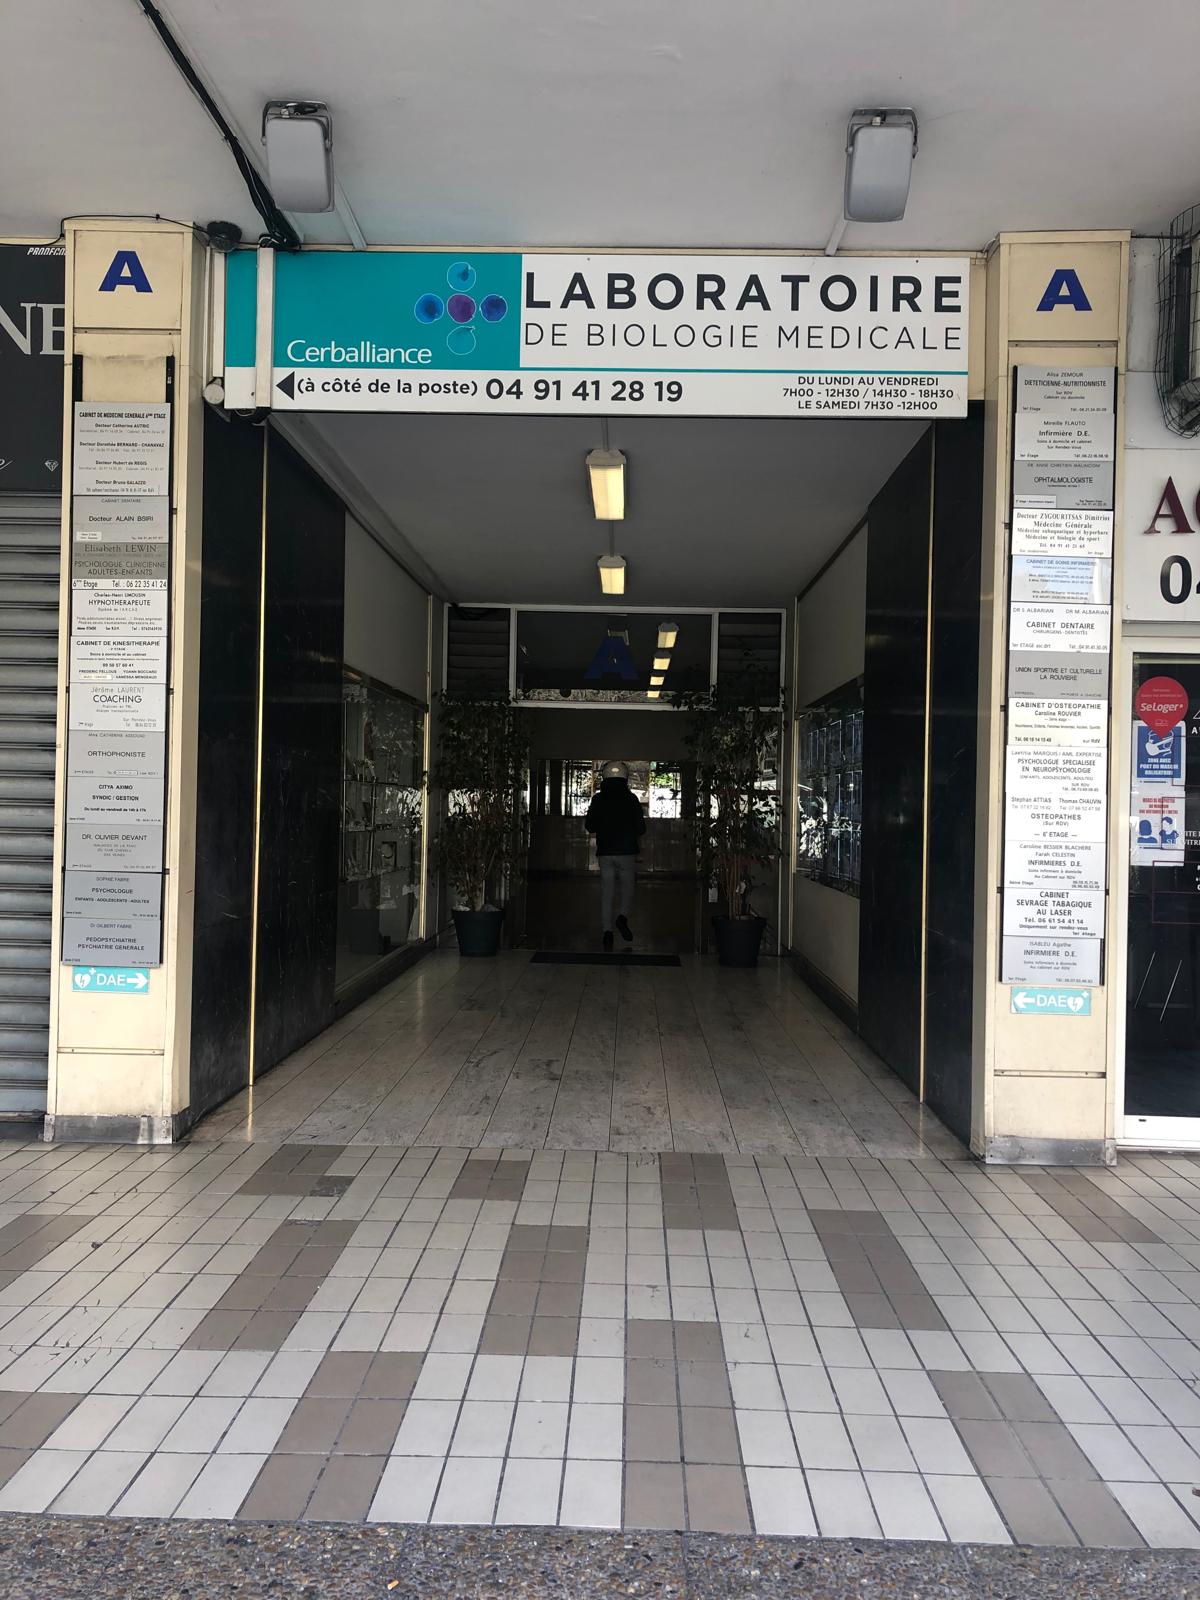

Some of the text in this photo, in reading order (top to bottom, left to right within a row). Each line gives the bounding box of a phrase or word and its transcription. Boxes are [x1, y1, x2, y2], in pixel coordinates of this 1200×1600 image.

[98, 250, 153, 292] A
[526, 272, 962, 313] LABORATOIRE
[1036, 269, 1092, 312] A
[525, 323, 961, 350] DE BIOLOGIE MEDICALE
[287, 340, 432, 364] Cerballiance
[298, 378, 683, 402] (à côté de la poste) 04 91 41 28 19
[798, 376, 939, 388] DU LUNDI AU VENDREDI
[782, 388, 814, 398] 7H00
[825, 388, 860, 398] 12H30
[862, 388, 868, 399] /
[872, 389, 907, 399] 14H30
[918, 389, 954, 400] 18H30
[798, 401, 938, 412] LE SAMEDI 7H30 -12H00
[1143, 475, 1200, 535] A
[1160, 555, 1200, 604] 0
[93, 694, 142, 703] COACHING
[1140, 702, 1178, 714] SeLoger
[1052, 901, 1092, 909] TABAGIQUE
[96, 973, 126, 986] DAE
[1037, 994, 1067, 1007] DAE
